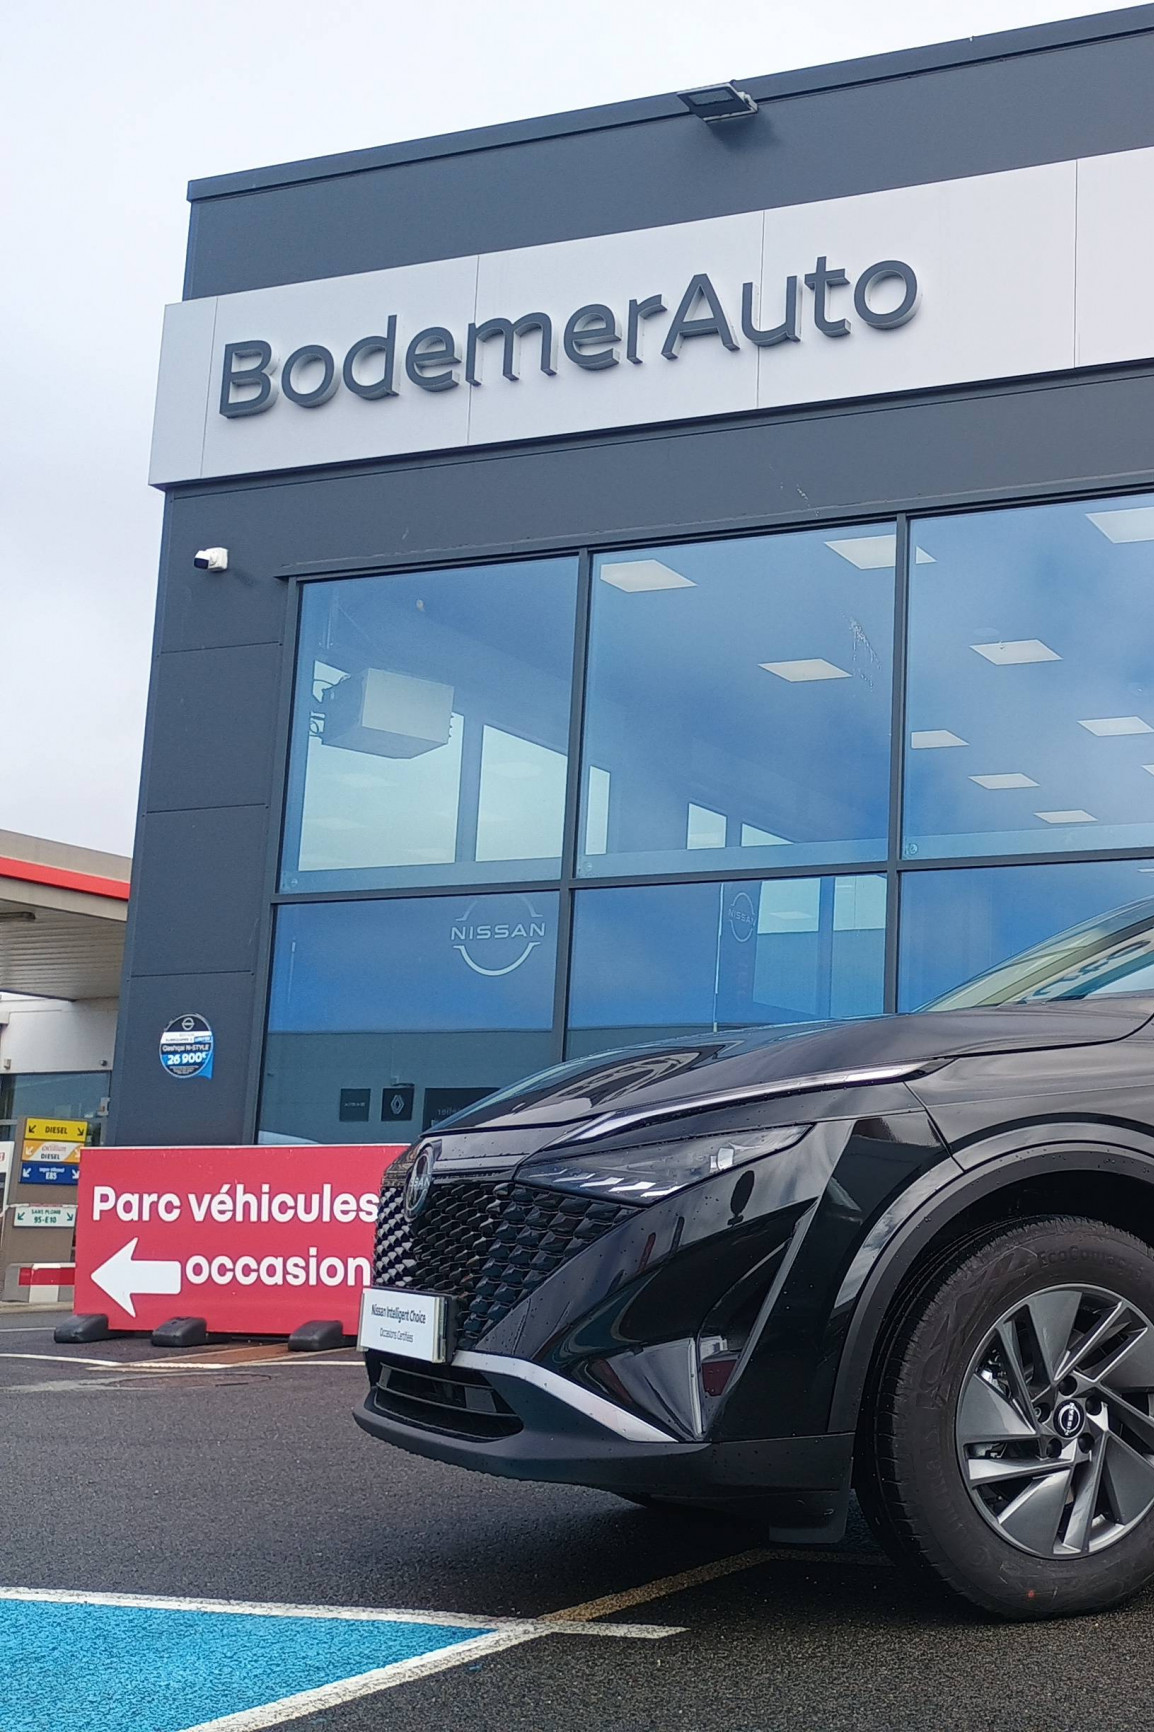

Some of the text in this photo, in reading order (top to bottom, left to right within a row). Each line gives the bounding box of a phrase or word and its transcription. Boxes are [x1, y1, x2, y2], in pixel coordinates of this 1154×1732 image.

[219, 256, 919, 419] BodemerAuto
[450, 921, 546, 941] NISSAN
[167, 1054, 180, 1065] 26
[45, 1126, 68, 1134] DIESEL
[92, 1184, 379, 1223] Parc véhicules
[185, 1247, 371, 1287] occasion
[387, 1306, 409, 1324] Intelligent
[409, 1309, 426, 1324] Choice
[1063, 1402, 1075, 1436] NISSAN
